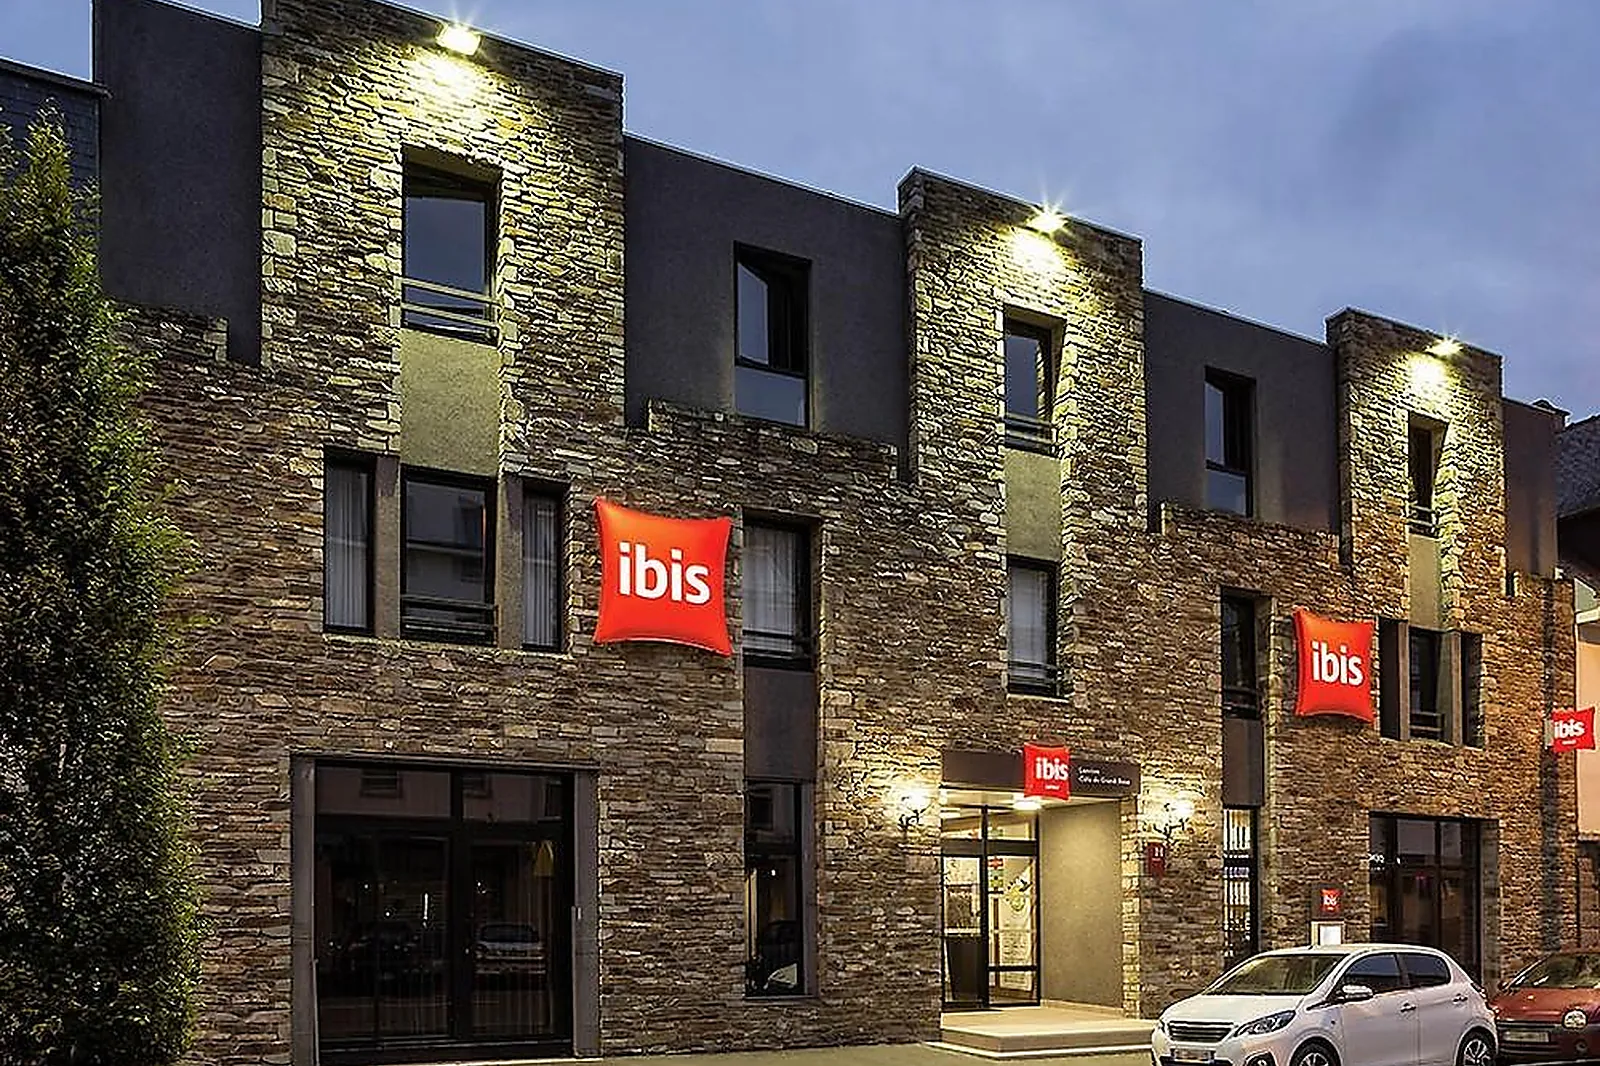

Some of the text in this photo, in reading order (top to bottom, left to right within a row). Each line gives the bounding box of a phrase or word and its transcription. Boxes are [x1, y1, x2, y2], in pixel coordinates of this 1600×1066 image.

[619, 541, 711, 605] ibis
[1311, 640, 1364, 686] ibis
[1554, 718, 1585, 738] ibis
[1035, 757, 1069, 780] ibis
